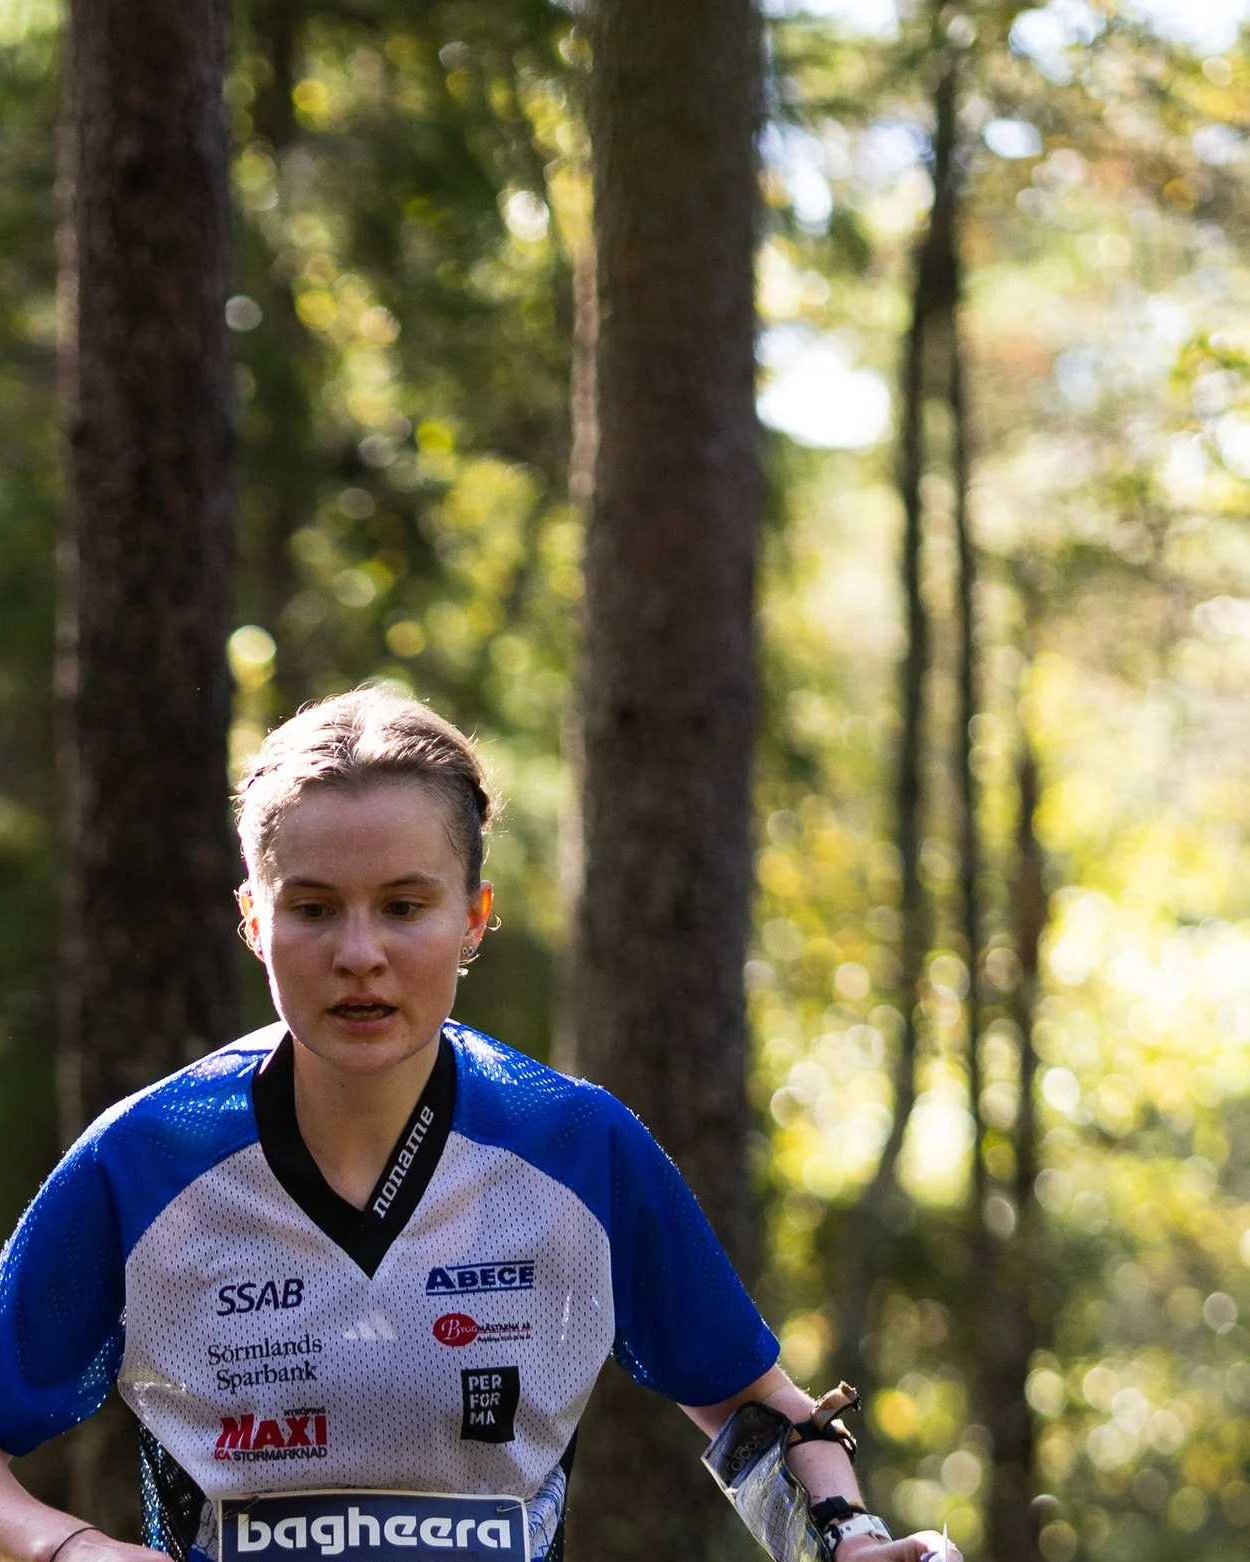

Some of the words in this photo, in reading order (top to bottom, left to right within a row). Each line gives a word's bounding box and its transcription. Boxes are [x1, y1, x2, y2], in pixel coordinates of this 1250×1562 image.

[372, 1105, 435, 1219] noname
[425, 1266, 535, 1291] ABECE
[216, 1278, 304, 1316] SSAB
[207, 1333, 323, 1366] Sörmlands
[216, 1360, 319, 1396] Sparbank
[468, 1374, 503, 1391] PER
[469, 1391, 501, 1409] FOR
[214, 1412, 328, 1450] MAXI
[469, 1409, 496, 1425] MA
[214, 1448, 232, 1461] ICA
[233, 1446, 328, 1462] STORMARKNAD
[237, 1506, 512, 1556] bagheera
